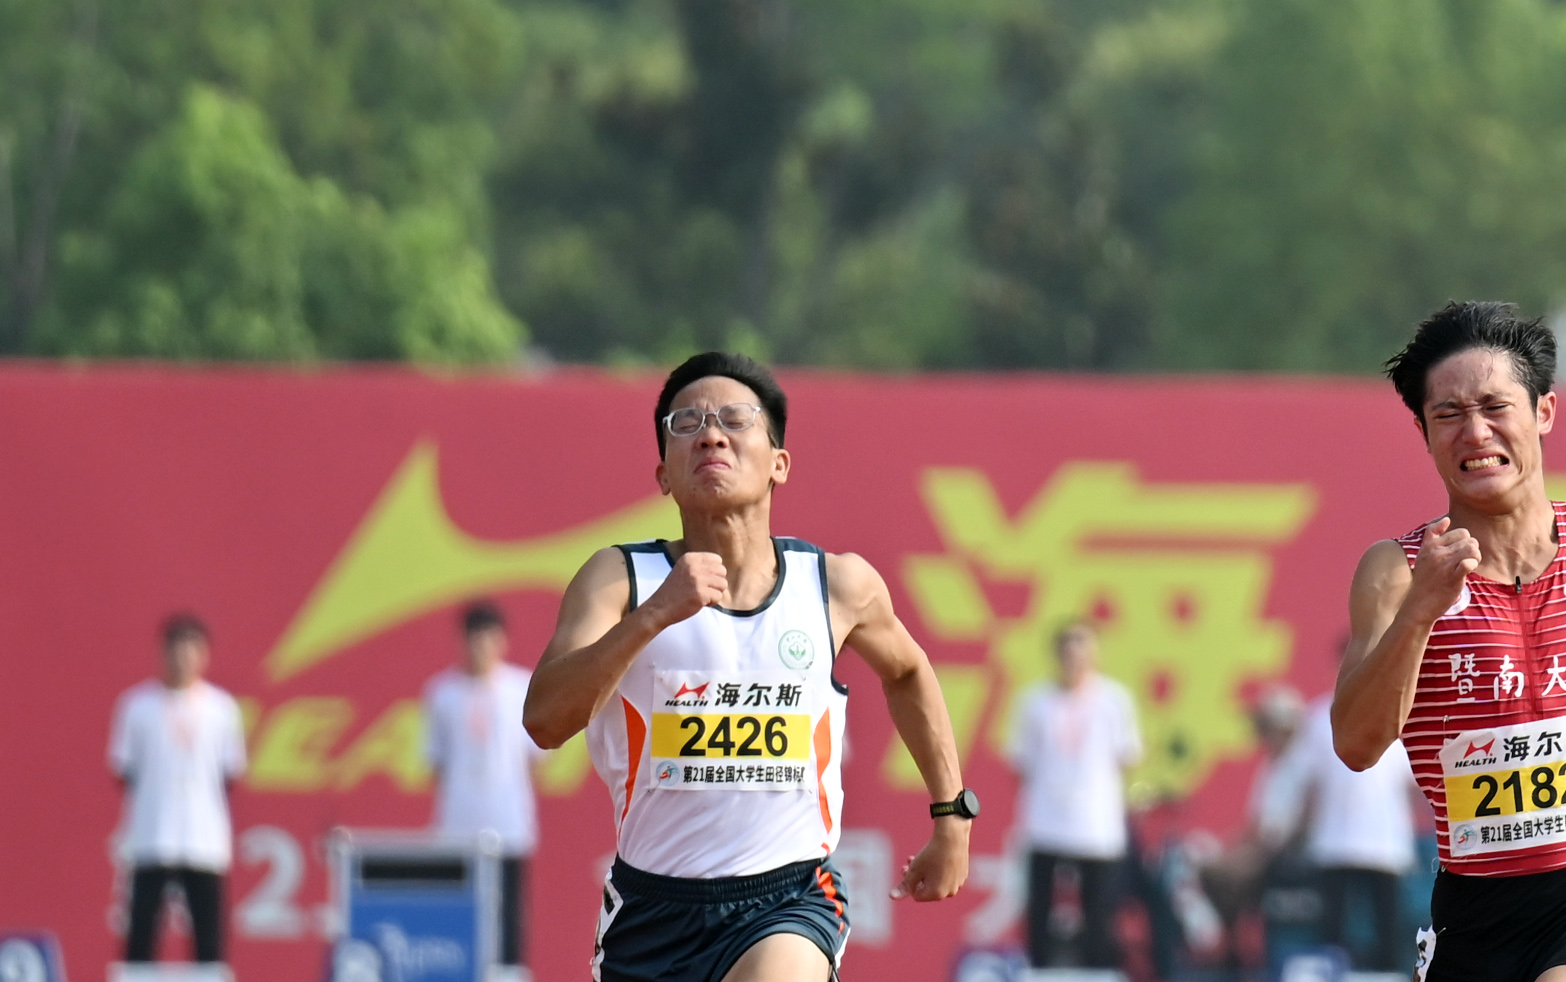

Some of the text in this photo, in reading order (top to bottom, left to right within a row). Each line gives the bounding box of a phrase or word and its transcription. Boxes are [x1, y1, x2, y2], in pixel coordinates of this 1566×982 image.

[664, 699, 709, 707] HEALTH
[714, 682, 803, 708] 海尔斯
[679, 715, 789, 757] 2426
[1454, 757, 1497, 769] HEALTH
